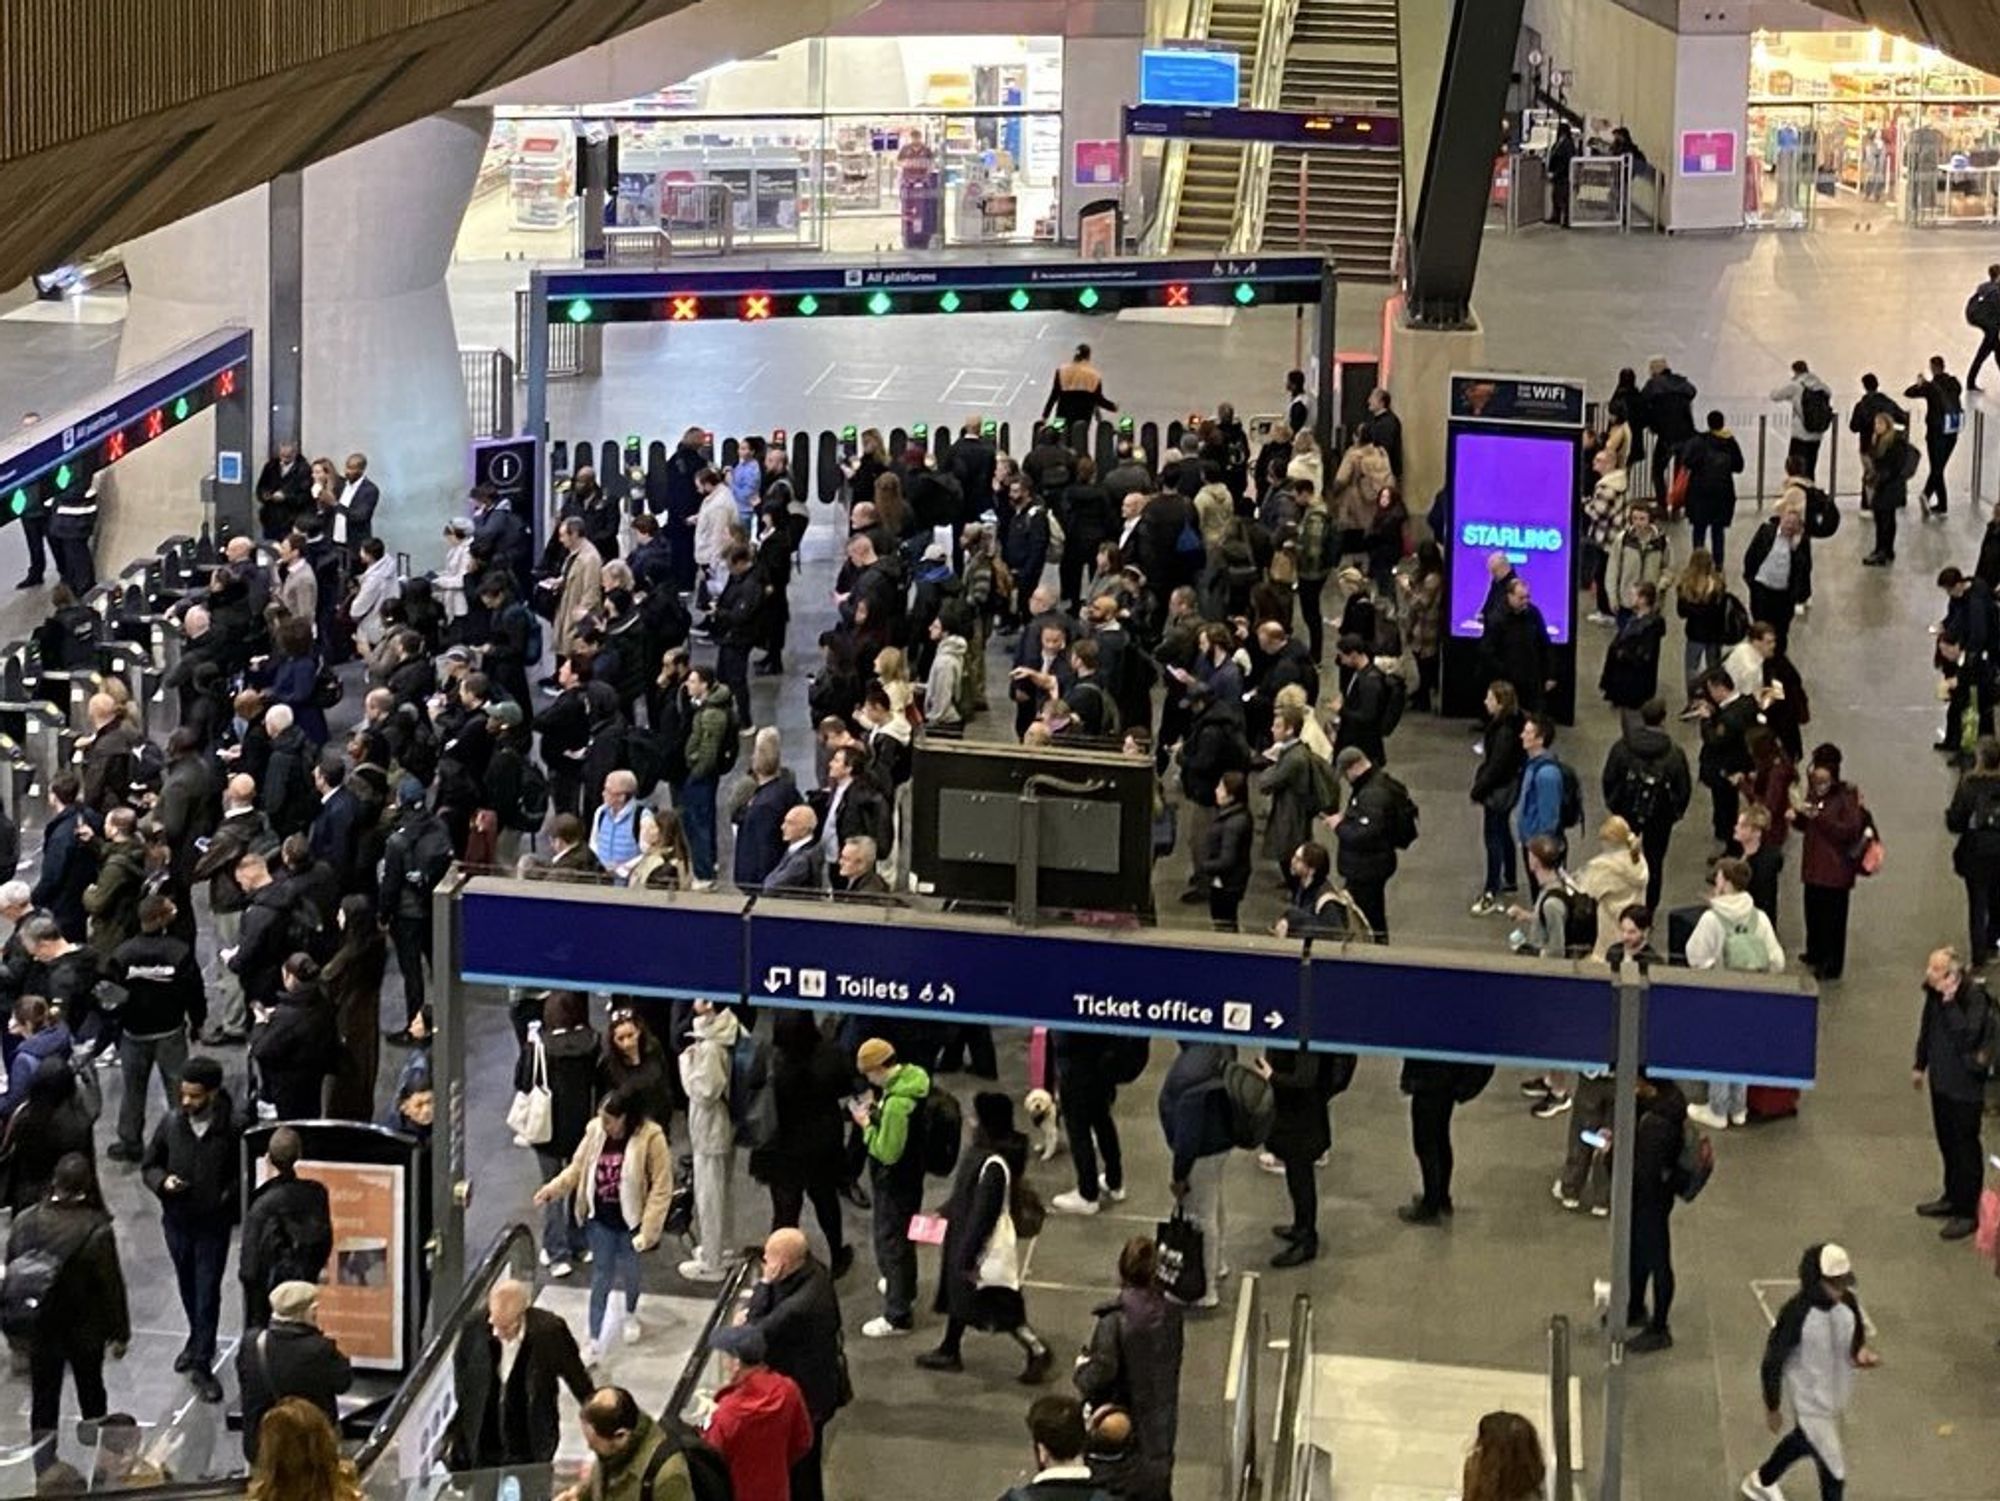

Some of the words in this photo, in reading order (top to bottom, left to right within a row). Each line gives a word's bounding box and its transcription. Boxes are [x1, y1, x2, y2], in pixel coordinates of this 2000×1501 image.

[866, 271, 882, 282] All
[884, 271, 937, 284] platforms
[1463, 524, 1562, 551] STARLING
[836, 975, 909, 1000] Toilets
[1073, 994, 1142, 1019] Ticket
[1147, 1000, 1213, 1025] office
